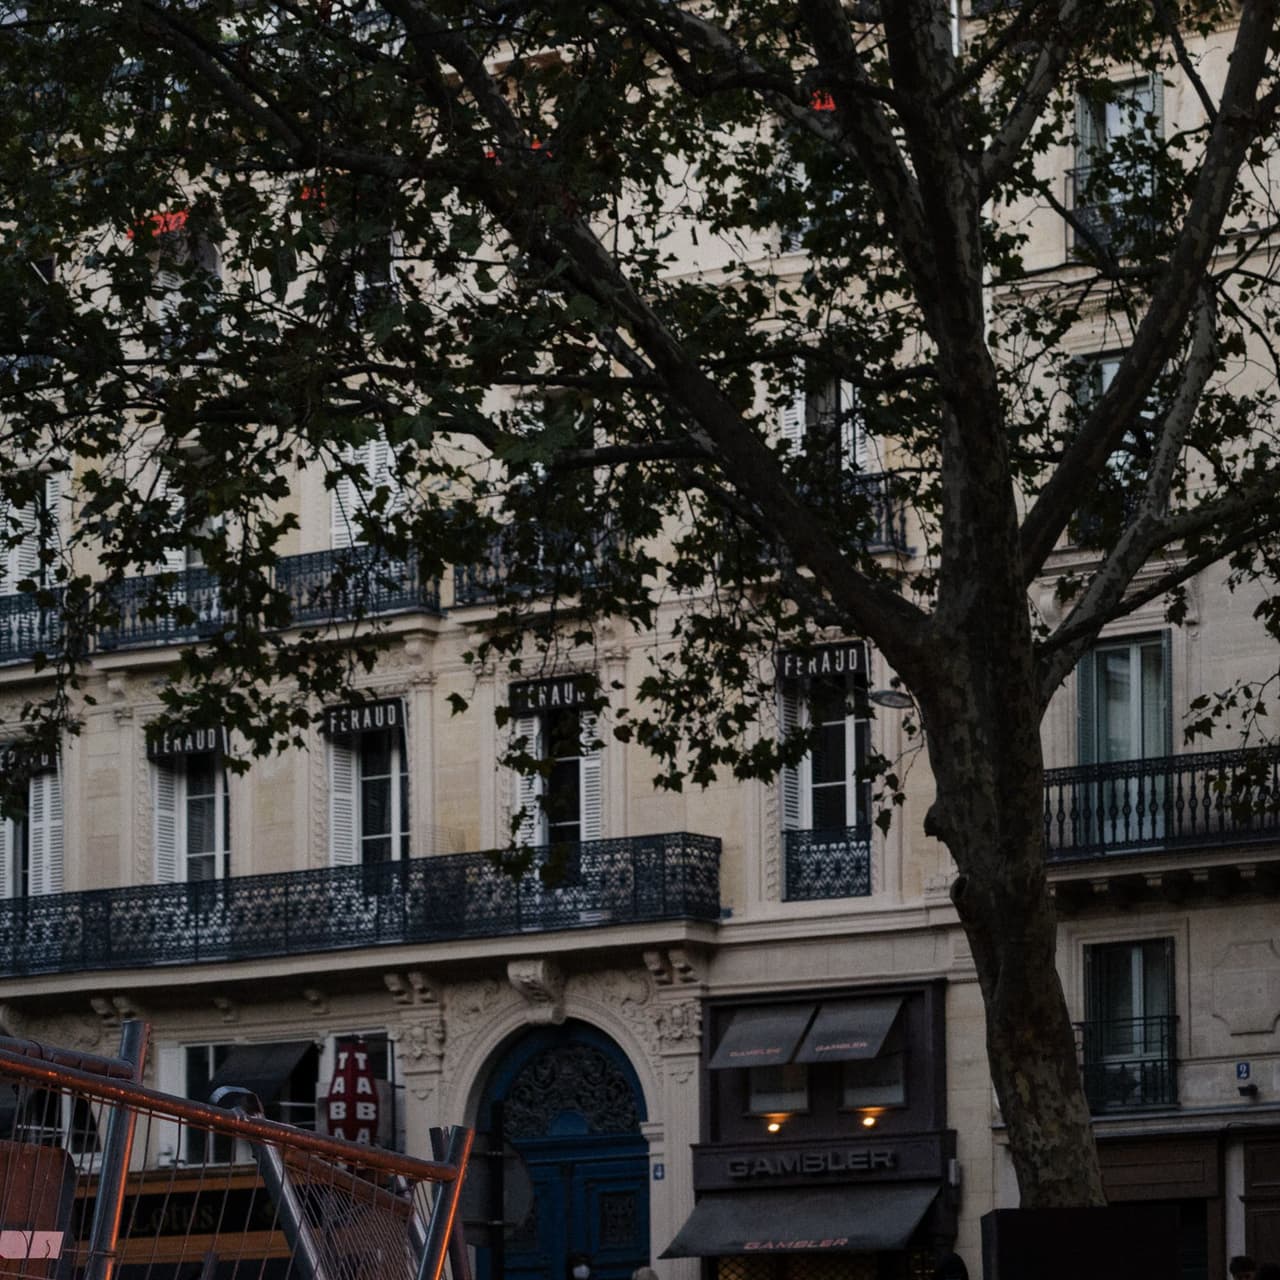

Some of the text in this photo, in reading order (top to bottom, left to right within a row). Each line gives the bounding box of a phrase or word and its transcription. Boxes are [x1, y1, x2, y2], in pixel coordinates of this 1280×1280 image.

[1239, 1063, 1249, 1079] 2
[726, 1147, 898, 1179] GAMBLER
[744, 1236, 849, 1251] GAMBLER
